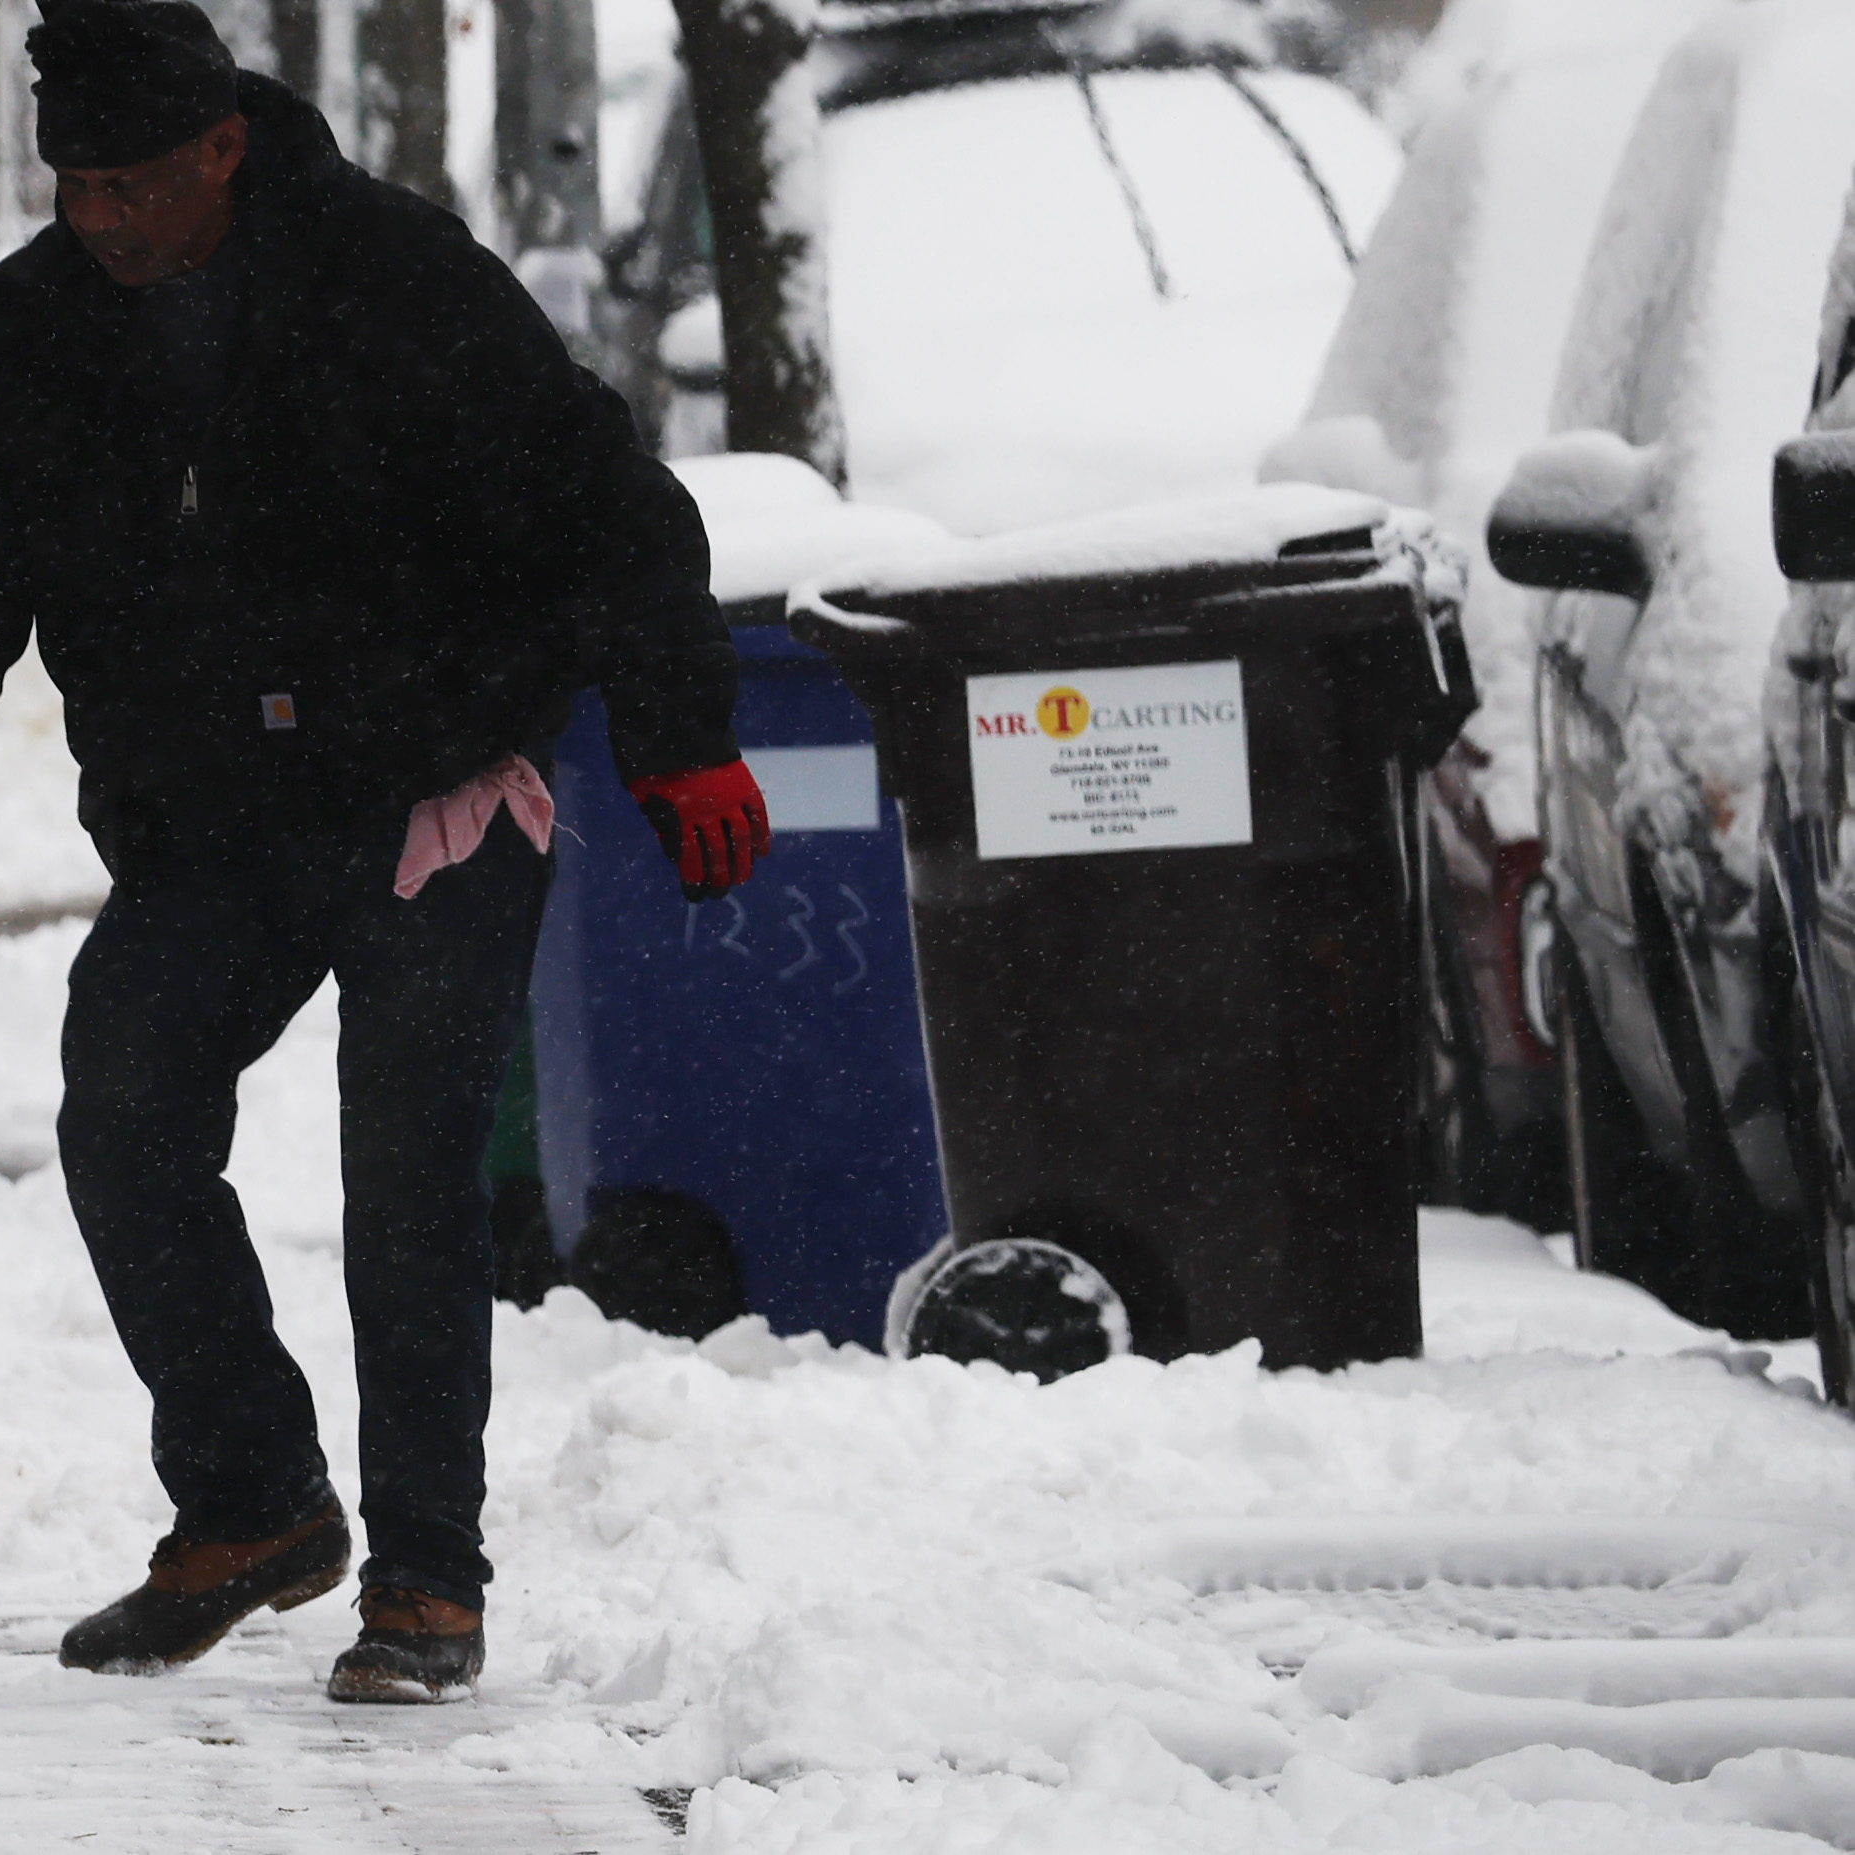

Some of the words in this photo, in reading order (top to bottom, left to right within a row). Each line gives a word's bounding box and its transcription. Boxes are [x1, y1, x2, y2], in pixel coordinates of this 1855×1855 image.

[976, 713, 1036, 737] MR.
[1044, 695, 1081, 733] T
[1090, 698, 1237, 729] CARTING
